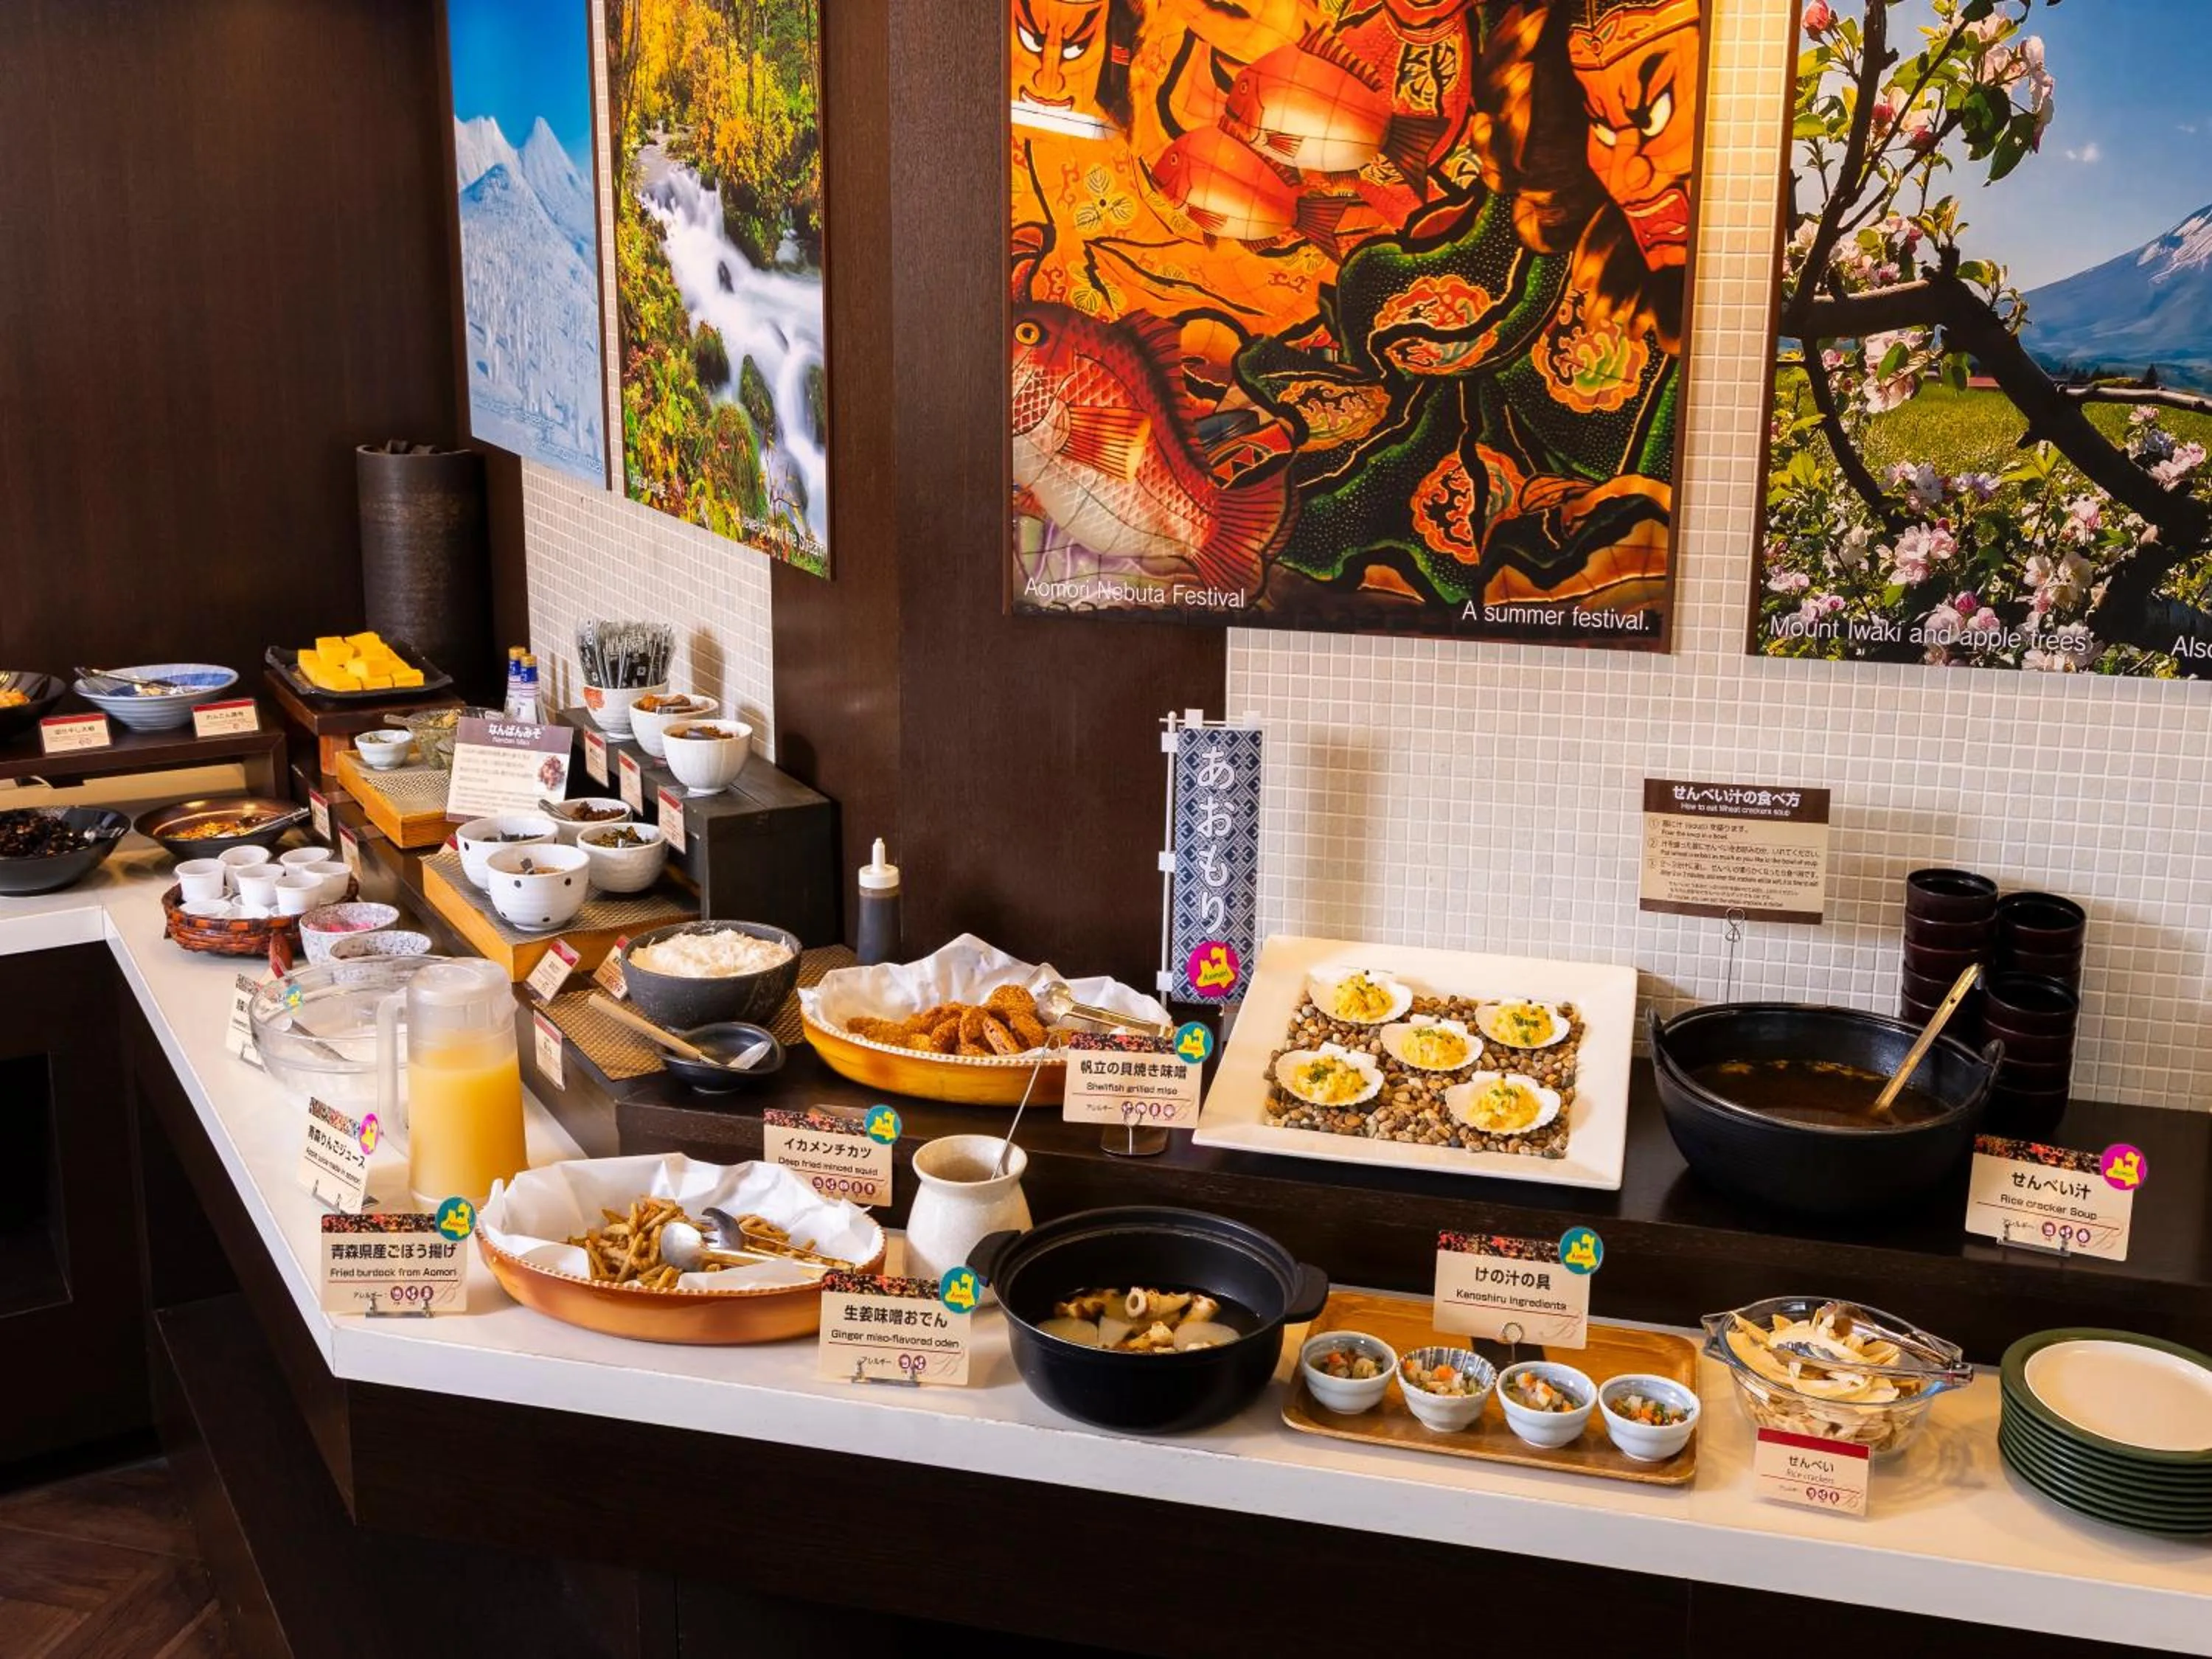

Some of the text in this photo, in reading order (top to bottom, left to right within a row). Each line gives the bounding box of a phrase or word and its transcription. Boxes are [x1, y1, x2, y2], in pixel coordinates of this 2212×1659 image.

[1024, 577, 1245, 608] Aomori Nebuta Festival
[1462, 600, 1650, 631] A summer festival.
[1770, 615, 2087, 652] Mount Iwaki and apple trees
[488, 723, 543, 740] なんばんみそ
[1672, 785, 1801, 808] せんべい汁の食べ方
[1197, 745, 1236, 934] あおもり
[1080, 1060, 1188, 1080] 帆立の貝焼き味噌
[1086, 1081, 1178, 1096] Shellfish grilled miso
[784, 1138, 872, 1159] イカメンチカツ
[778, 1155, 878, 1177] Deep fried minced squid
[2011, 1172, 2091, 1200] せんべい汁
[2000, 1194, 2097, 1221] Rice cracker Soup
[331, 1243, 458, 1261] 青森県産ごぼう揚げ
[330, 1267, 457, 1278] Fried burdock from Aomori
[1475, 1266, 1551, 1290] けの汁の具
[844, 1304, 948, 1329] 生姜味噌おでん
[831, 1329, 959, 1349] Ginger miso-flavored oden
[1790, 1455, 1834, 1472] せんべい
